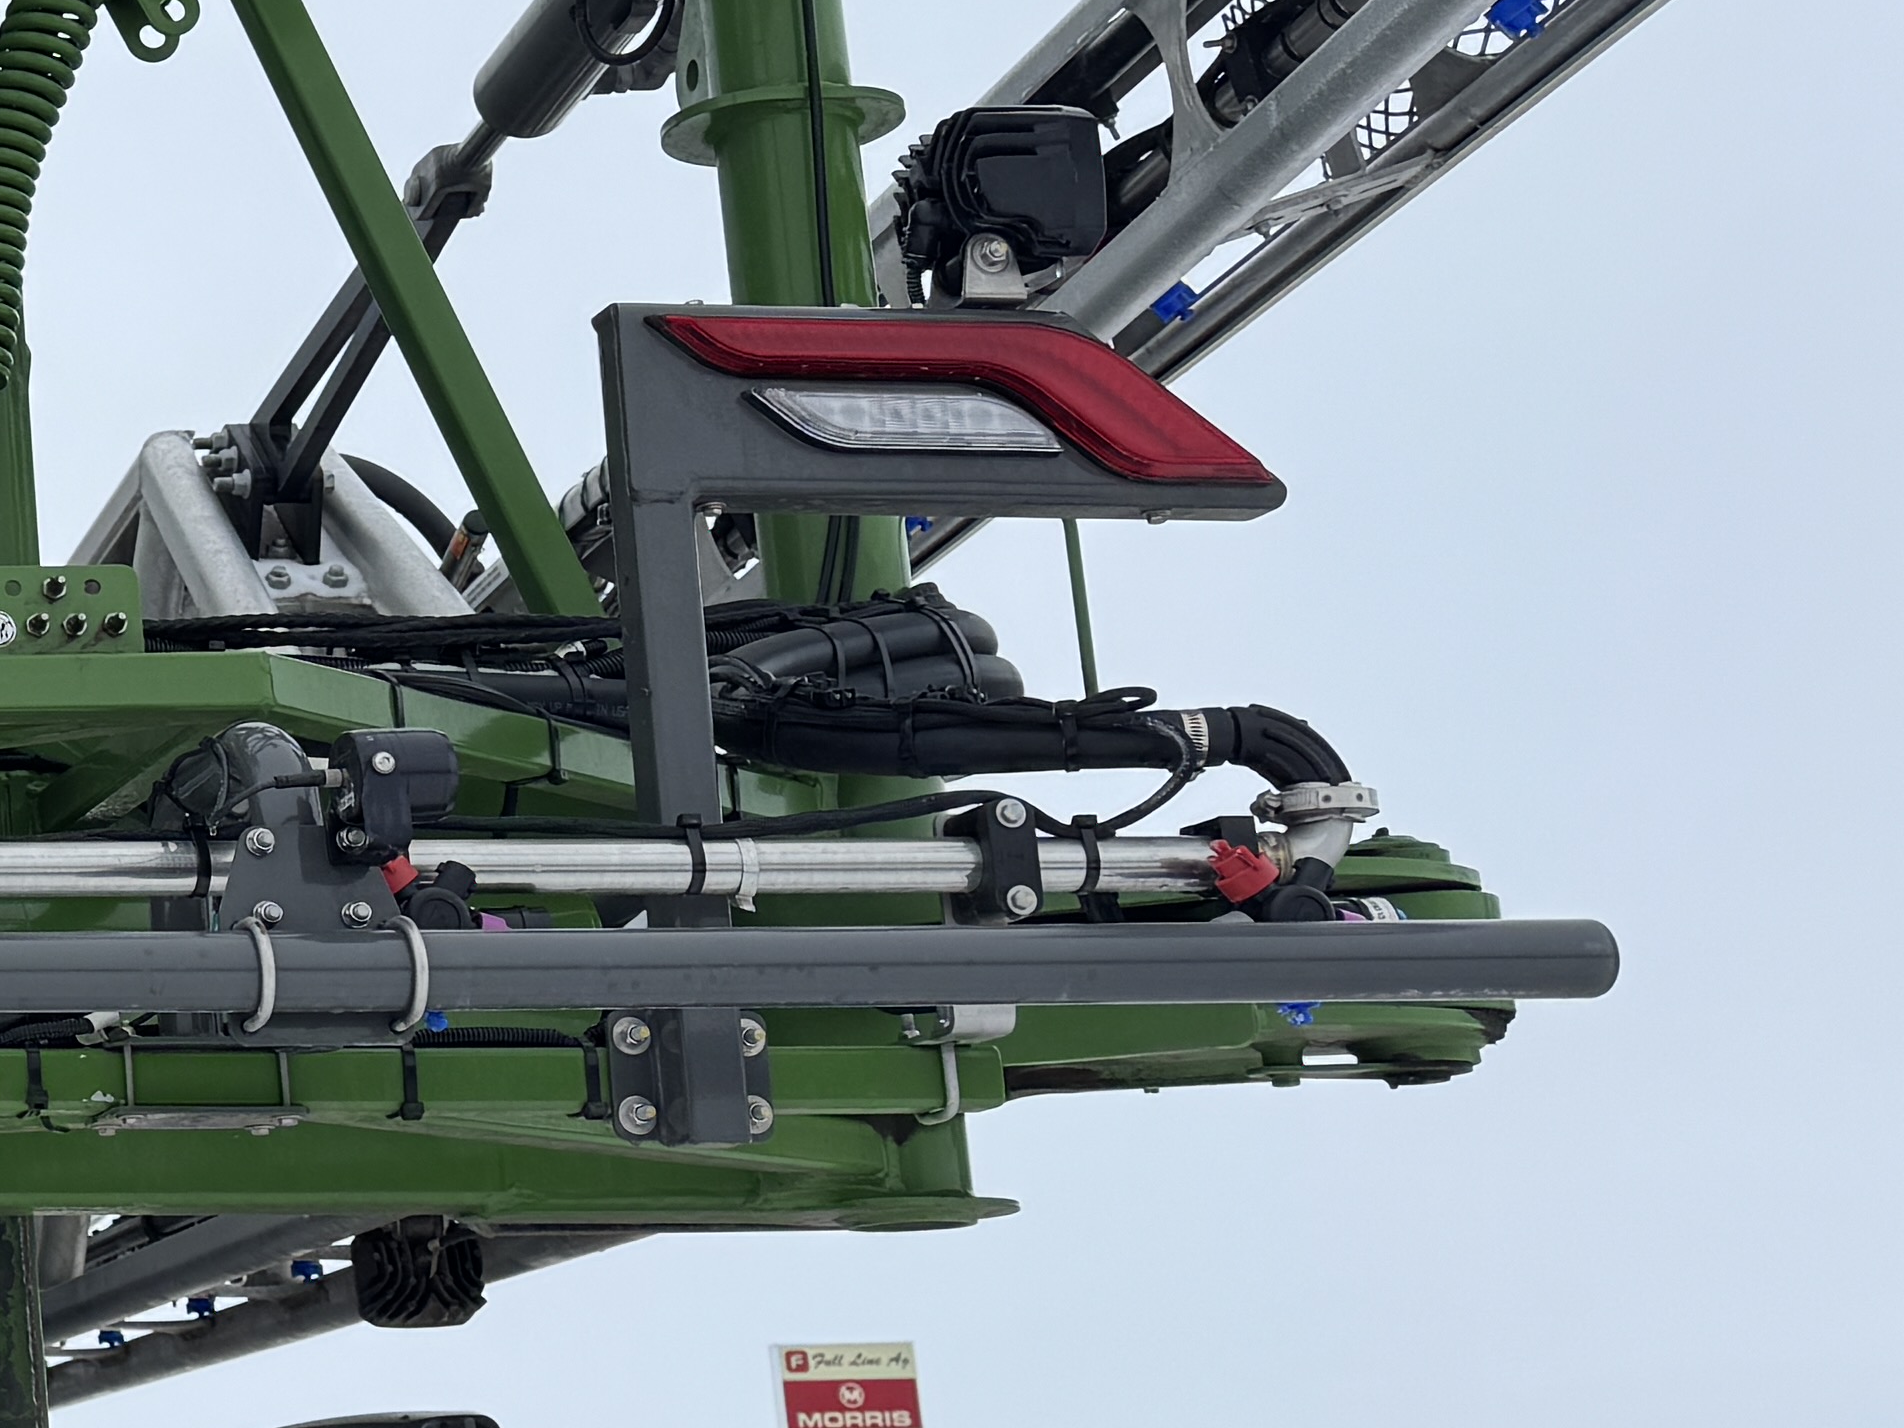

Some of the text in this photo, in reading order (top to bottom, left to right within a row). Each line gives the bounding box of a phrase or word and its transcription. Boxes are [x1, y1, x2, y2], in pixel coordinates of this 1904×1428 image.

[812, 1352, 844, 1370] Full
[848, 1352, 882, 1367] Line
[887, 1351, 910, 1369] Ag
[796, 1410, 912, 1428] MORRIS
